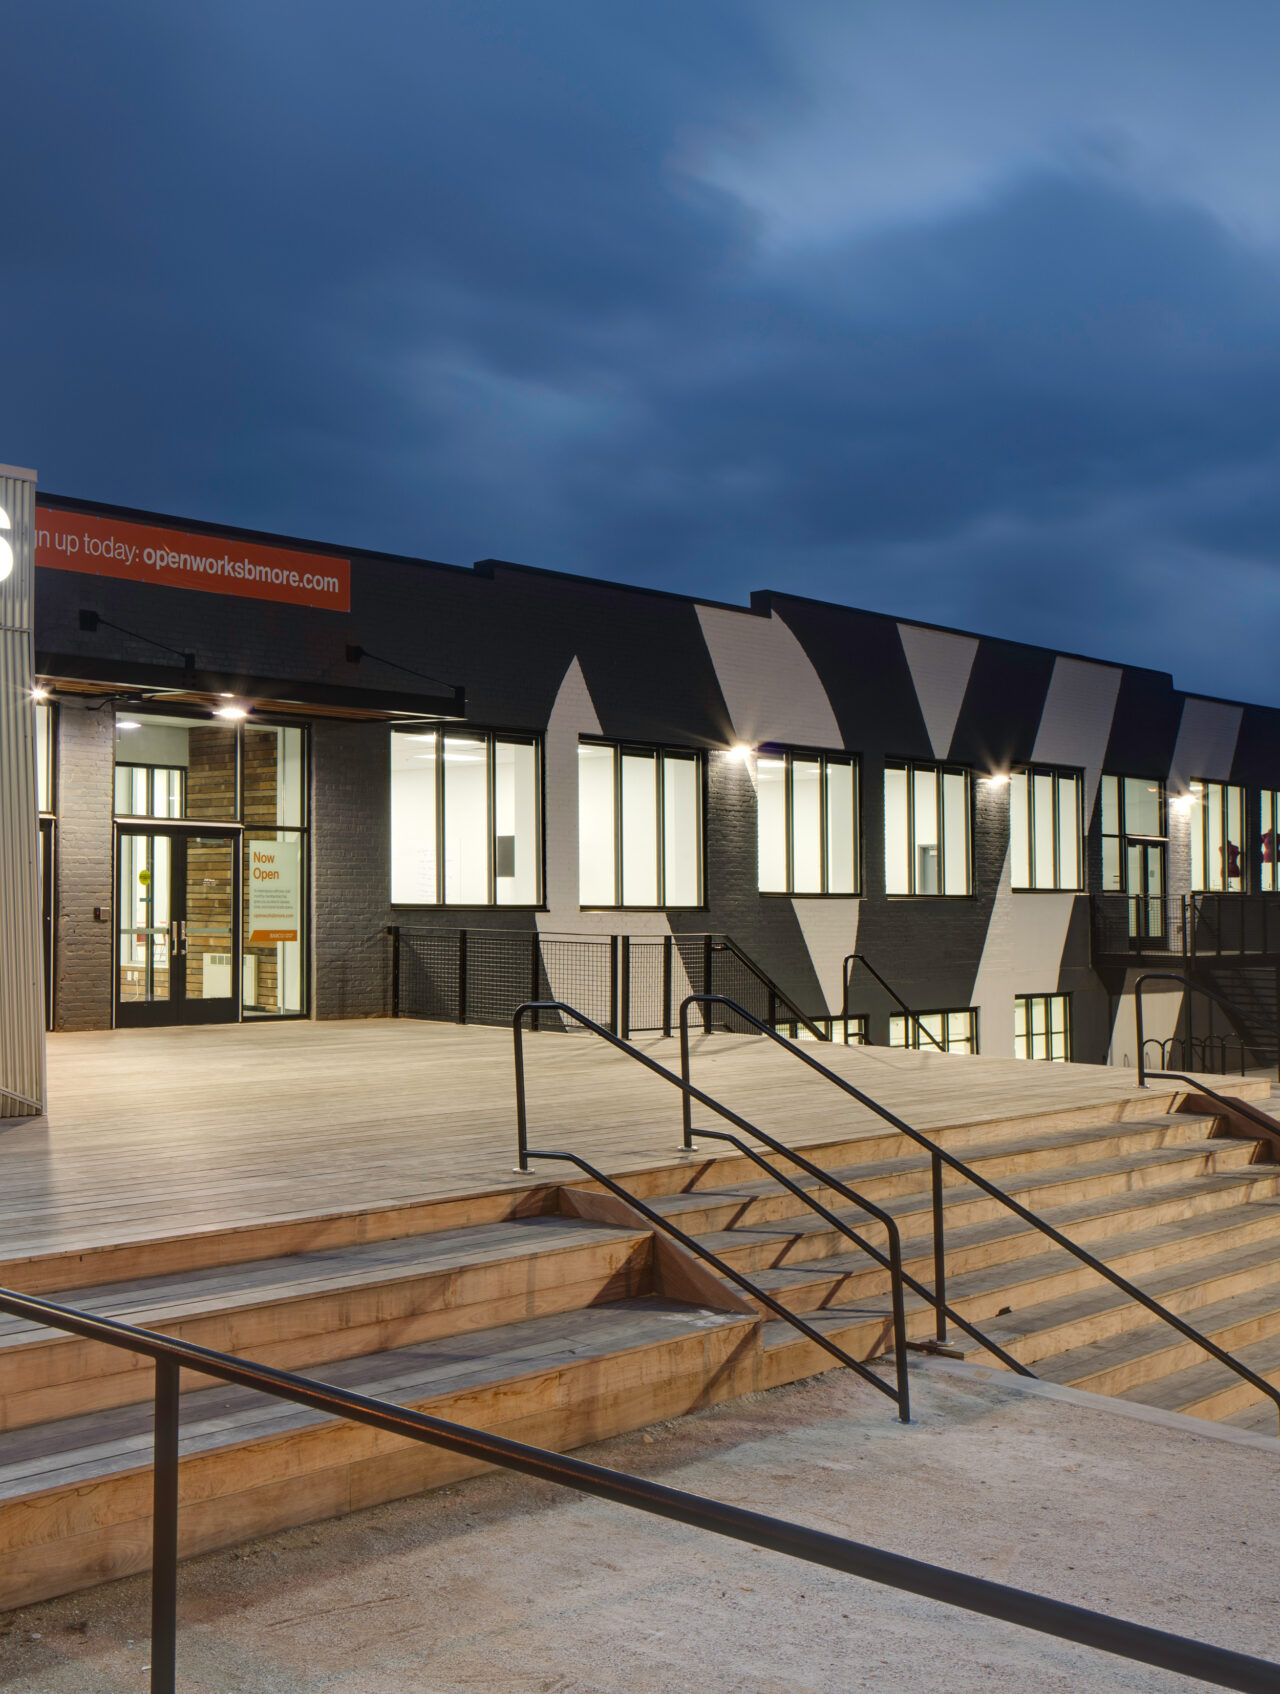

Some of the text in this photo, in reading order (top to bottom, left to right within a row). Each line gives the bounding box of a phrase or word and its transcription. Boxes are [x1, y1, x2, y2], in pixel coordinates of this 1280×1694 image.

[34, 529, 339, 593] n up today: openworksbmore.com
[253, 851, 275, 864] Now
[253, 867, 279, 882] Open
